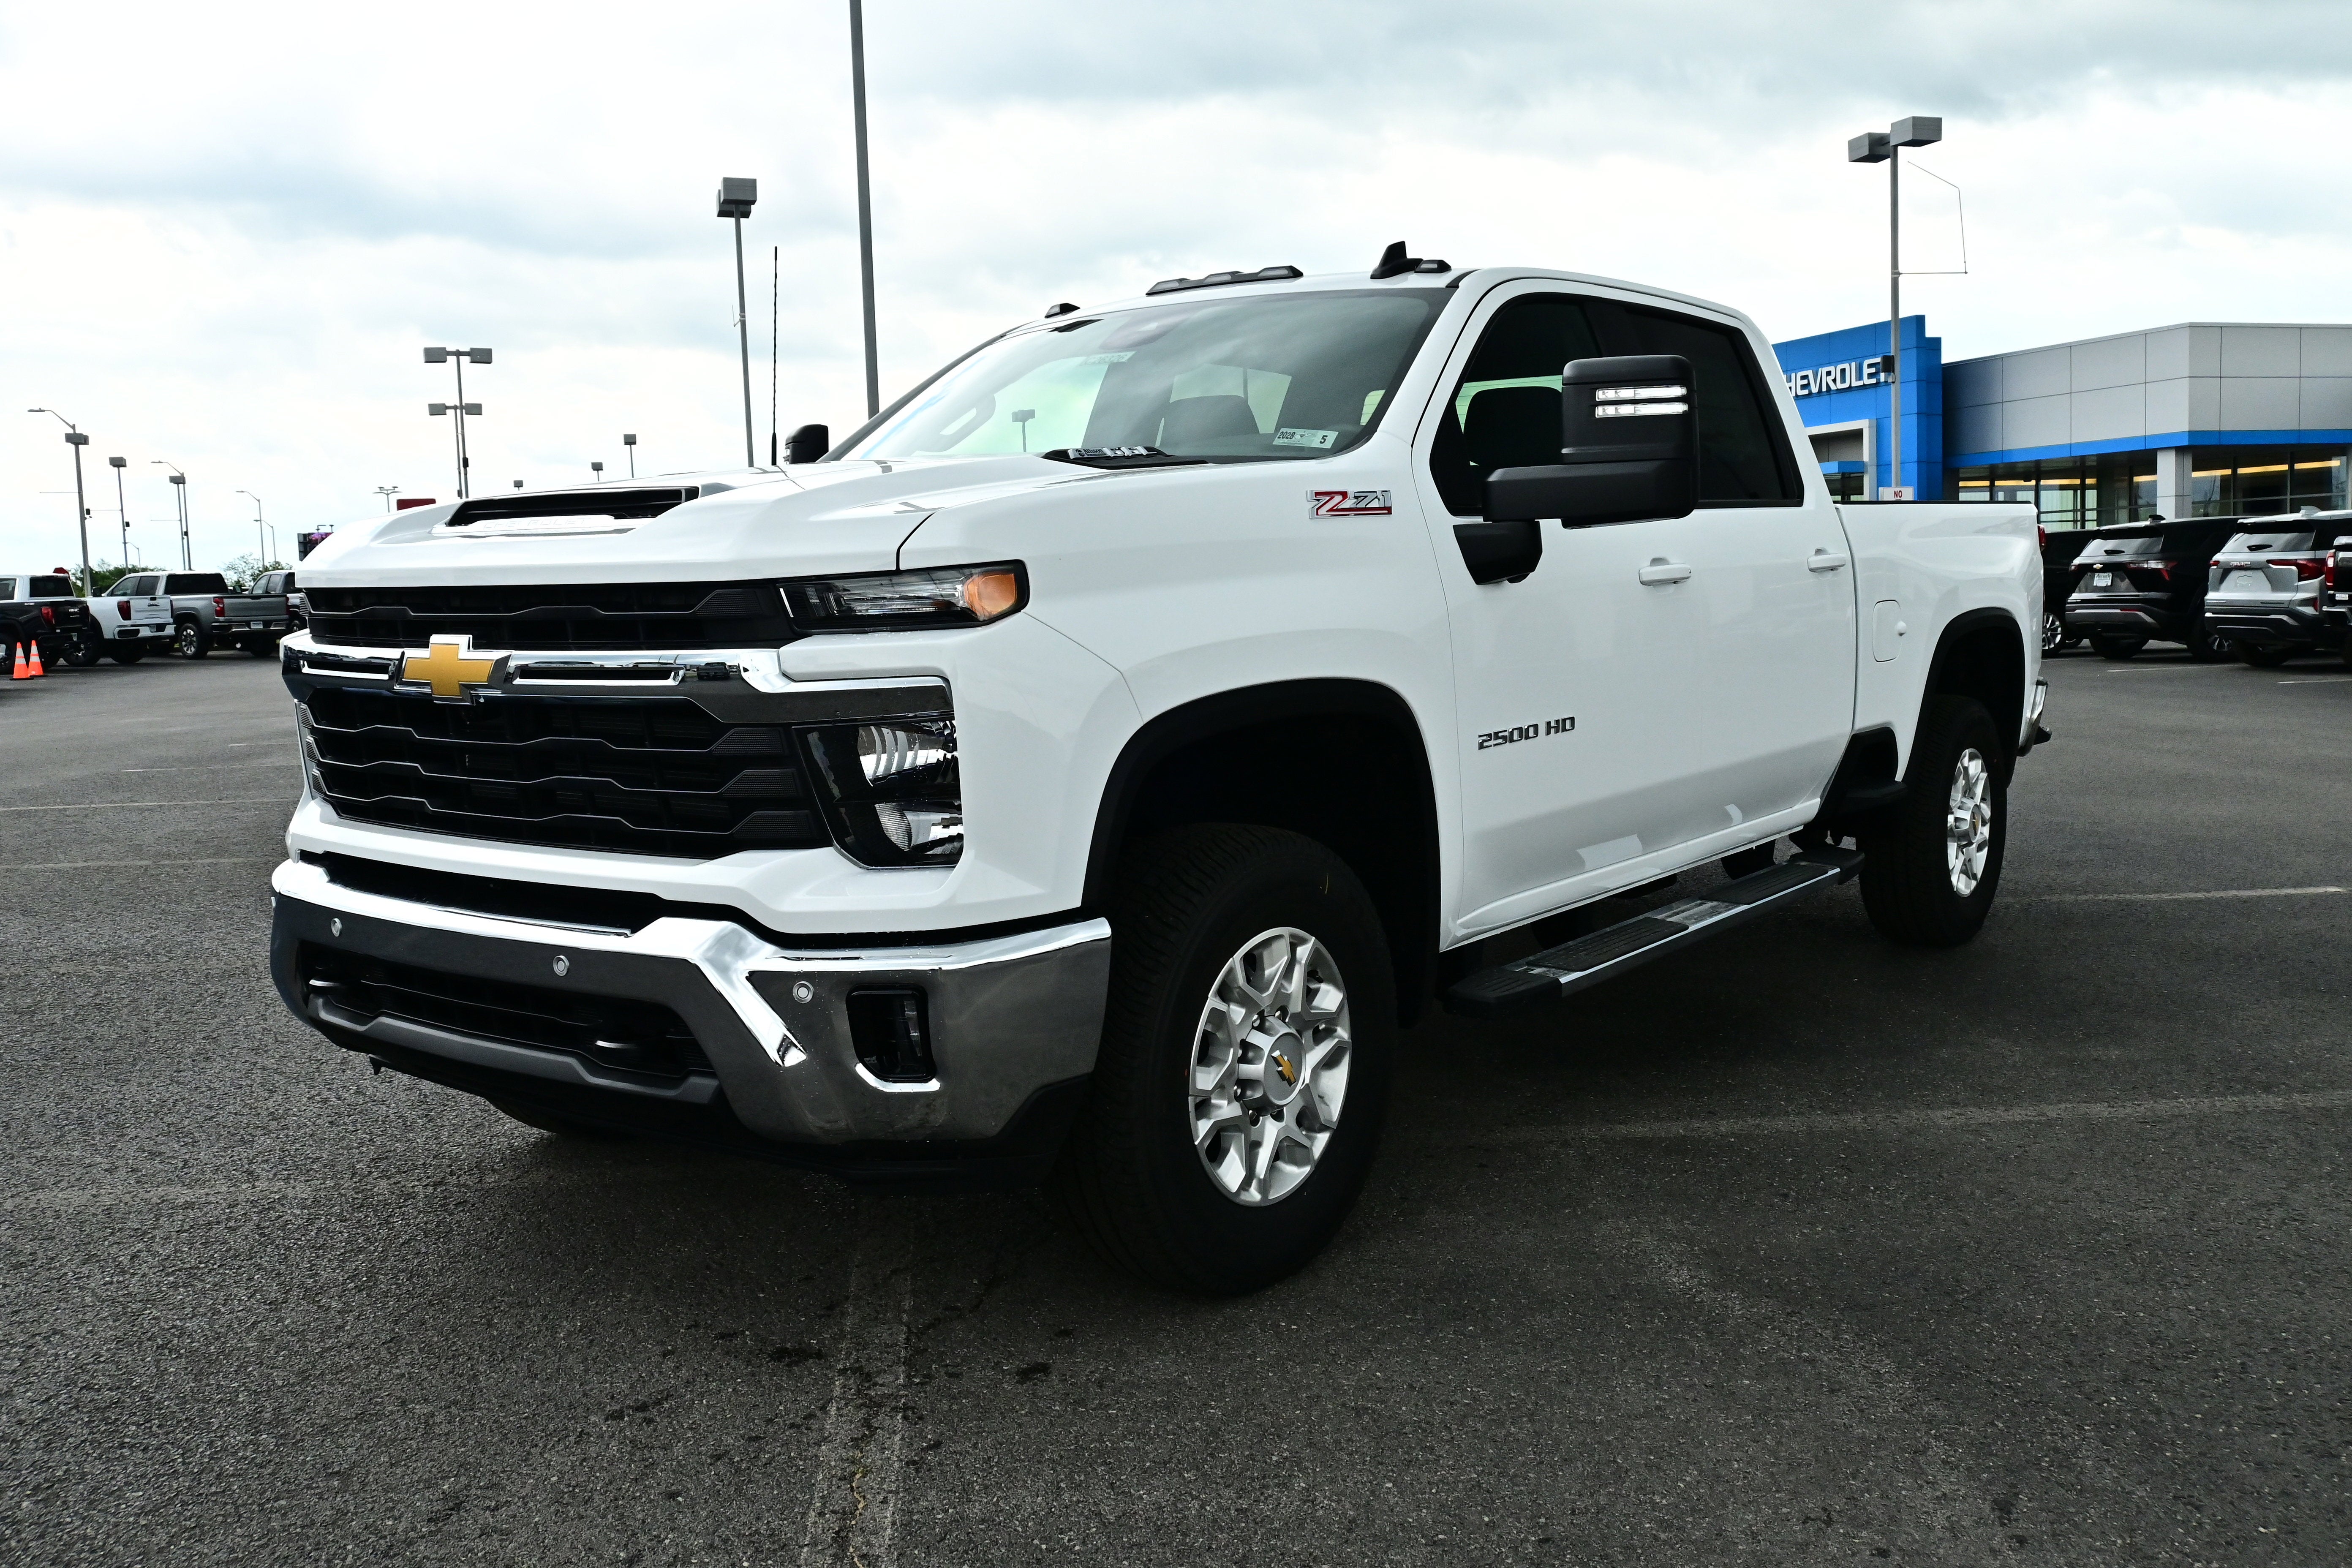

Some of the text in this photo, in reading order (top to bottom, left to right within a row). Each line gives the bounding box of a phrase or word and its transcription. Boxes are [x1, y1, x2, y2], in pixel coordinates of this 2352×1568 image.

[1277, 431, 1296, 440] 2028
[1319, 435, 1328, 444] 5
[1306, 490, 1392, 519] Z71
[1894, 490, 1903, 498] NO
[1478, 716, 1575, 750] 2500 HD
